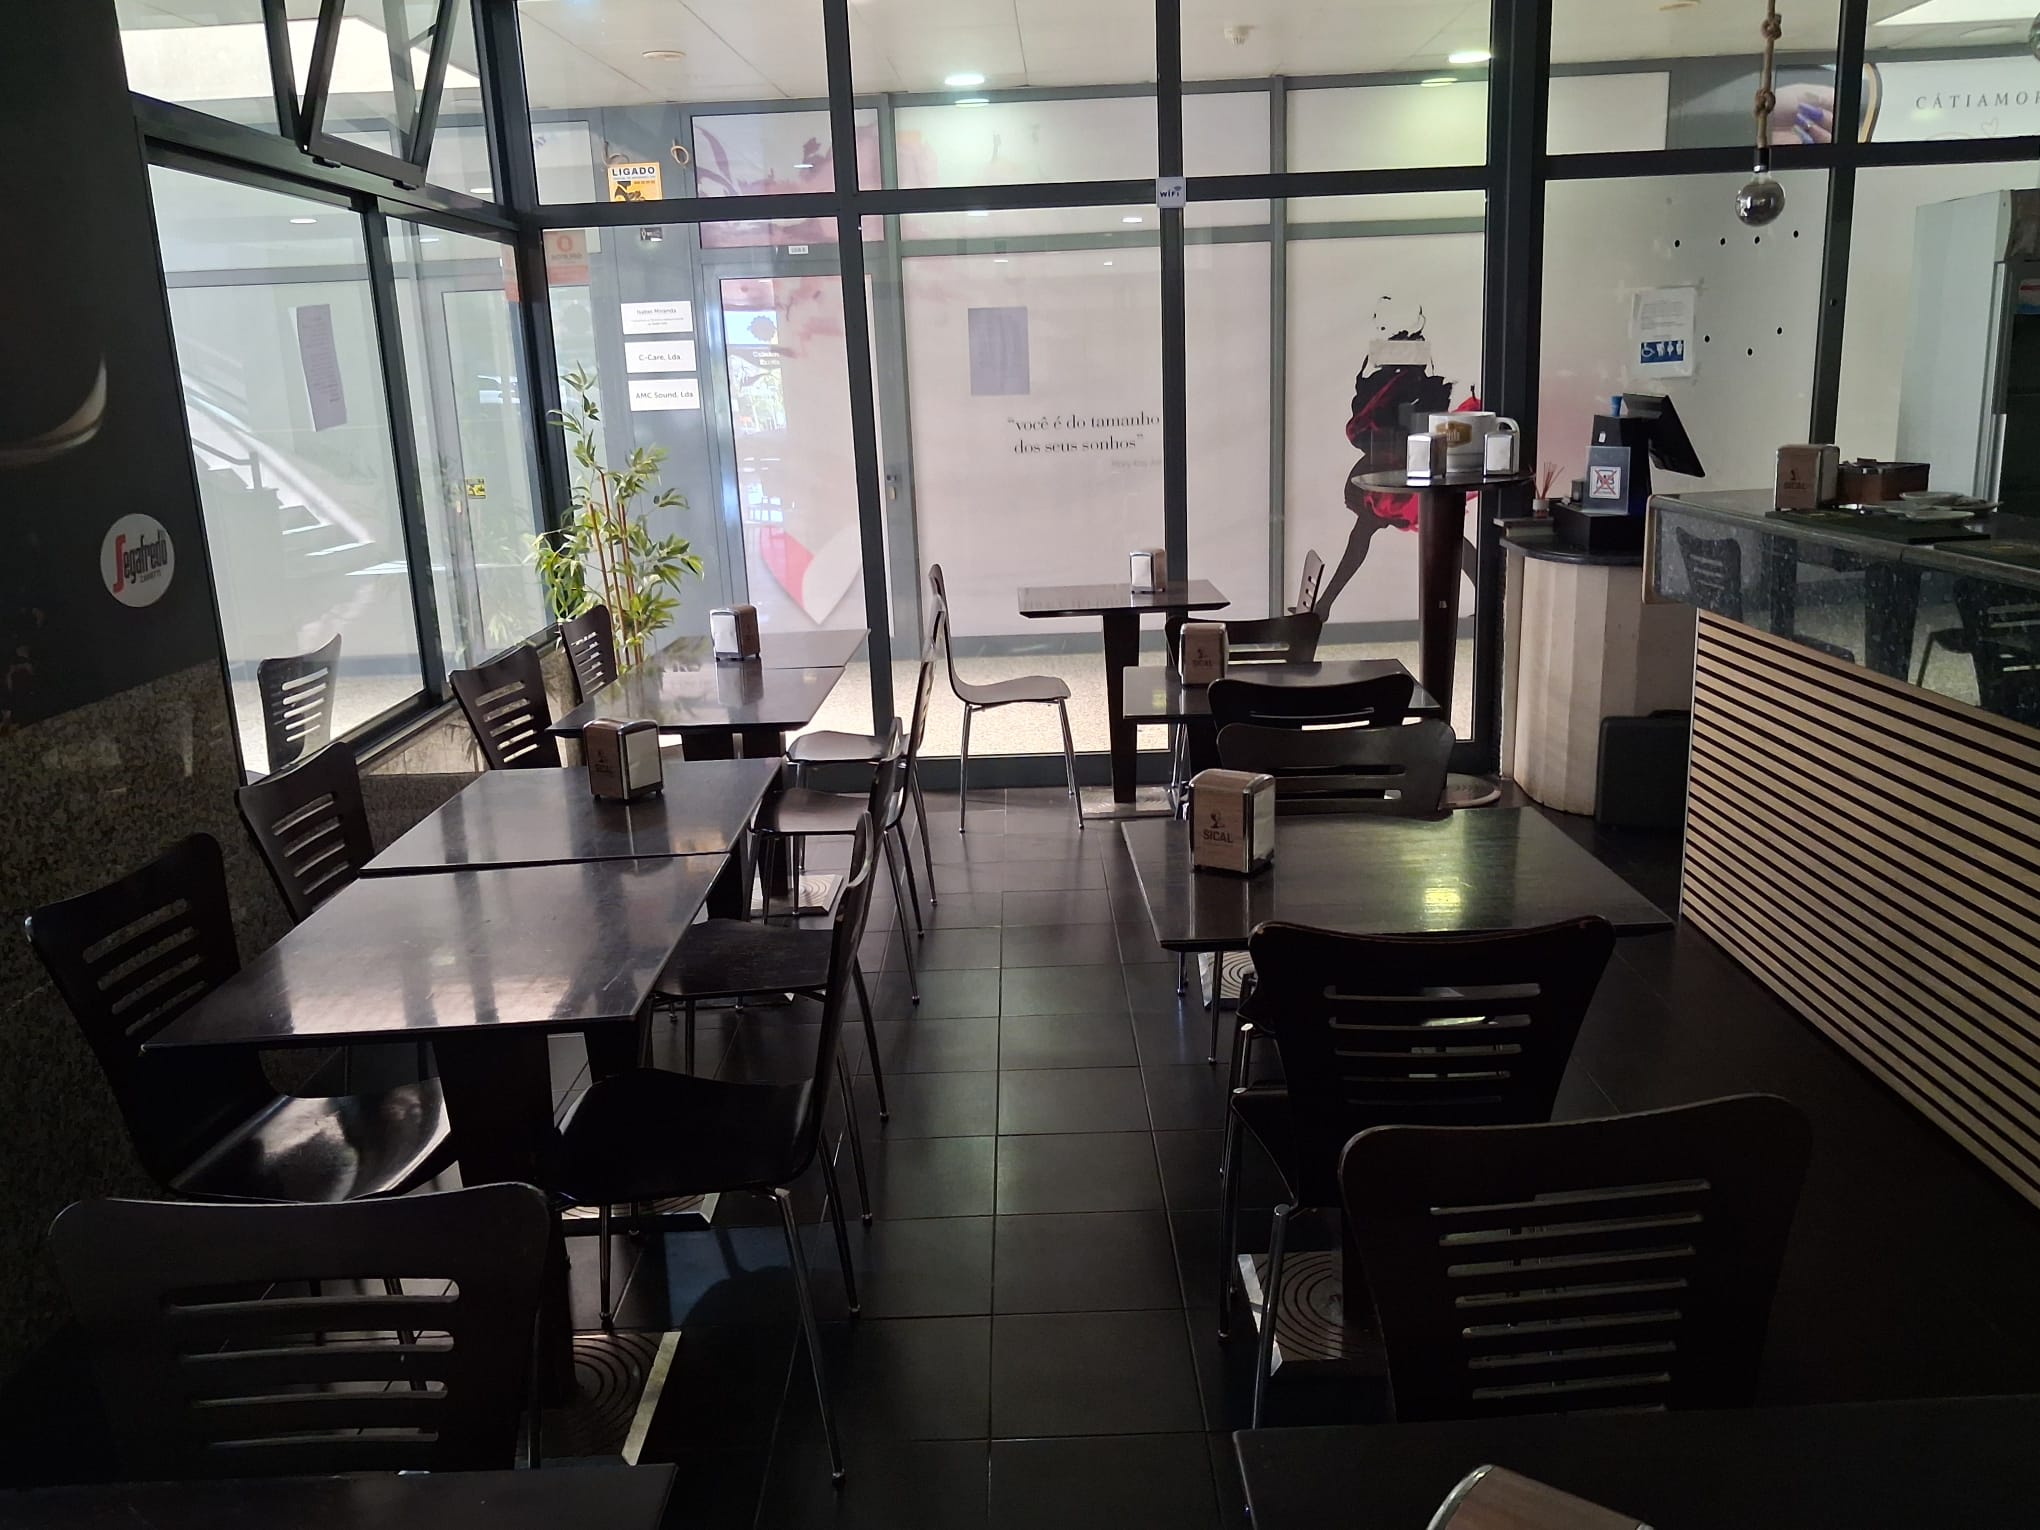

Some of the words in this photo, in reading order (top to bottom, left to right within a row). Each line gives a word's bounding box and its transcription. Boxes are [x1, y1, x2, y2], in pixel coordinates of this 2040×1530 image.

[612, 166, 655, 177] LIGADO
[667, 353, 681, 361] Lda
[1053, 416, 1062, 430] é
[1066, 413, 1086, 430] do
[1090, 410, 1160, 429] tamanho
[1014, 439, 1041, 454] dos
[1044, 442, 1078, 453] seus
[112, 529, 168, 594] Segafredo
[1202, 828, 1234, 845] SICAL
